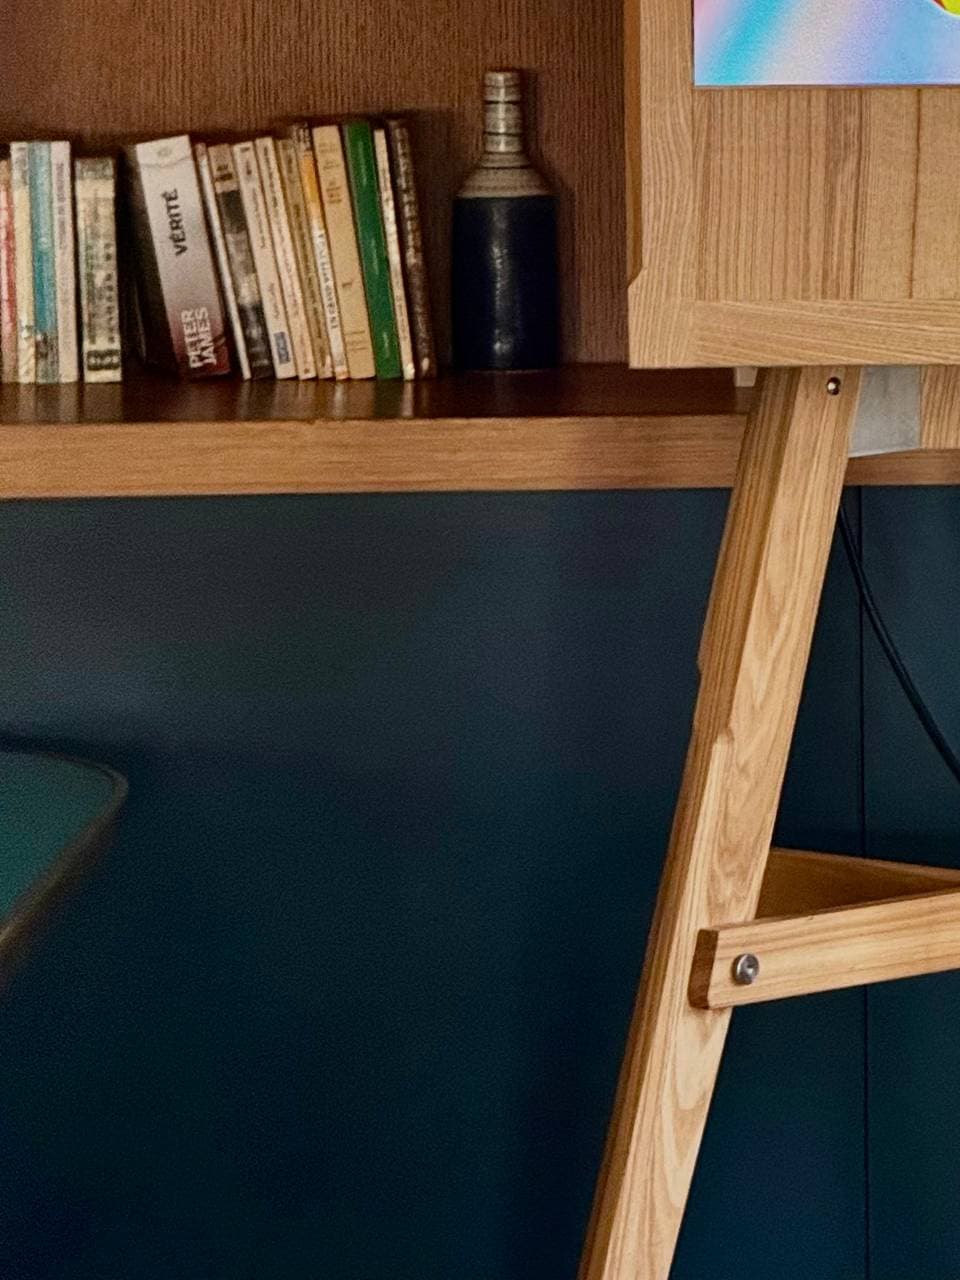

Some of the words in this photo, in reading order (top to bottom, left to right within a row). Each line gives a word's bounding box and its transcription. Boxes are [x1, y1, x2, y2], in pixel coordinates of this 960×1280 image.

[161, 187, 188, 257] VÉRITÉ
[181, 308, 200, 369] PETER
[194, 306, 217, 367] JAMES
